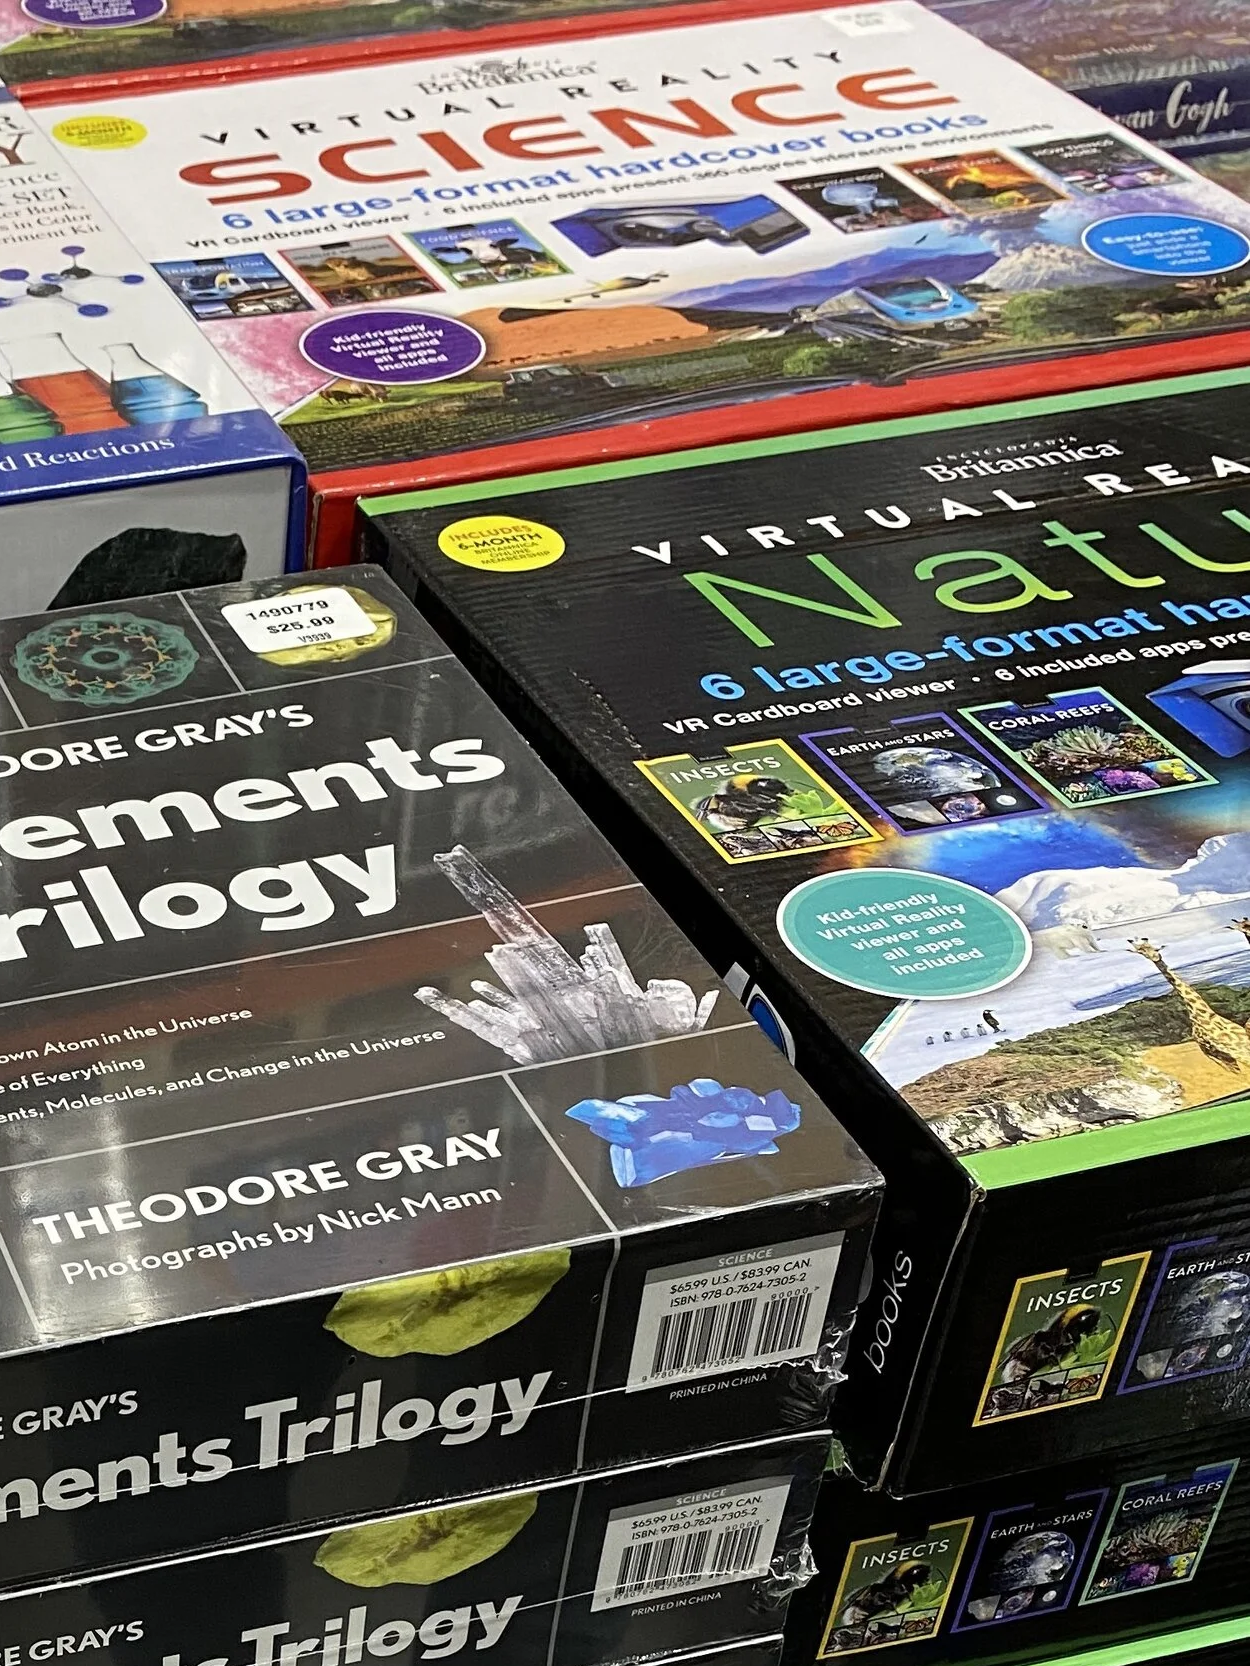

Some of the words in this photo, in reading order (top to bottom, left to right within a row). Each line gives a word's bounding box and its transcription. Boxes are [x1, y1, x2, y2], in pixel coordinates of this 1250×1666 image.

[200, 95, 516, 147] VIRTUAL
[558, 49, 844, 100] REALITY
[1166, 80, 1235, 134] Gogh
[178, 66, 960, 206] SCIENCE
[222, 213, 254, 230] 6
[264, 169, 582, 220] large-format
[586, 133, 830, 180] hardcover
[839, 112, 988, 146] books
[14, 185, 72, 203] SET
[329, 338, 385, 354] Virtual
[389, 329, 444, 347] Reality
[332, 322, 427, 346] Kid-friendly
[21, 434, 176, 471] Reactions
[920, 442, 1124, 484] Britannica
[448, 525, 532, 541] INCLUDES
[458, 533, 542, 550] 6-MONTH
[631, 489, 1037, 564] VIRTUAL
[247, 599, 329, 622] 1490779
[267, 615, 336, 636] $25.99
[699, 670, 746, 700] 6
[752, 606, 1165, 689] large-format
[1161, 595, 1250, 625] ha
[663, 717, 709, 736] VR
[713, 692, 864, 728] Cardboard
[867, 677, 958, 701] viewer
[994, 668, 1014, 682] 6
[1016, 648, 1136, 679] included
[1139, 640, 1206, 658] apps
[134, 704, 314, 754] GRAY'S
[987, 712, 1055, 732] CORAL
[1054, 702, 1116, 722] REEFS
[668, 754, 783, 785] INSECTS
[815, 918, 890, 941] Virtual
[891, 902, 966, 926] Reality
[816, 891, 939, 926] Kid-friendly
[850, 929, 920, 951] viewer
[925, 918, 966, 936] and
[882, 947, 910, 963] all
[913, 934, 966, 955] apps
[890, 947, 985, 976] included
[42, 1037, 100, 1058] Atom
[101, 1031, 121, 1046] in
[123, 1024, 159, 1041] the
[158, 1007, 253, 1034] Universe
[9, 1076, 30, 1092] of
[32, 1056, 146, 1088] Everything
[44, 1081, 163, 1115] Molecules,
[166, 1071, 204, 1091] and
[206, 1057, 291, 1083] Change
[293, 1053, 314, 1068] in
[315, 1045, 350, 1063] the
[350, 1028, 446, 1056] Universe
[32, 1159, 349, 1245] THEODORE
[355, 1127, 503, 1181] GRAY
[60, 1227, 273, 1285] Photographs
[279, 1218, 316, 1244] by
[319, 1199, 403, 1236] Nick
[405, 1184, 503, 1214] Mann
[717, 1248, 774, 1268] SCIENCE
[701, 1272, 807, 1300] 978-0-7624-7305-2
[1026, 1278, 1124, 1313] INSECTS
[863, 1251, 913, 1373] books
[669, 1383, 717, 1400] PRINTED
[717, 1380, 730, 1390] IN
[731, 1373, 767, 1387] CHINA
[12, 1389, 139, 1436] GRAY'S
[244, 1370, 553, 1471] Trilogy
[1121, 1493, 1172, 1512] CORAL
[1176, 1480, 1224, 1501] REEFS
